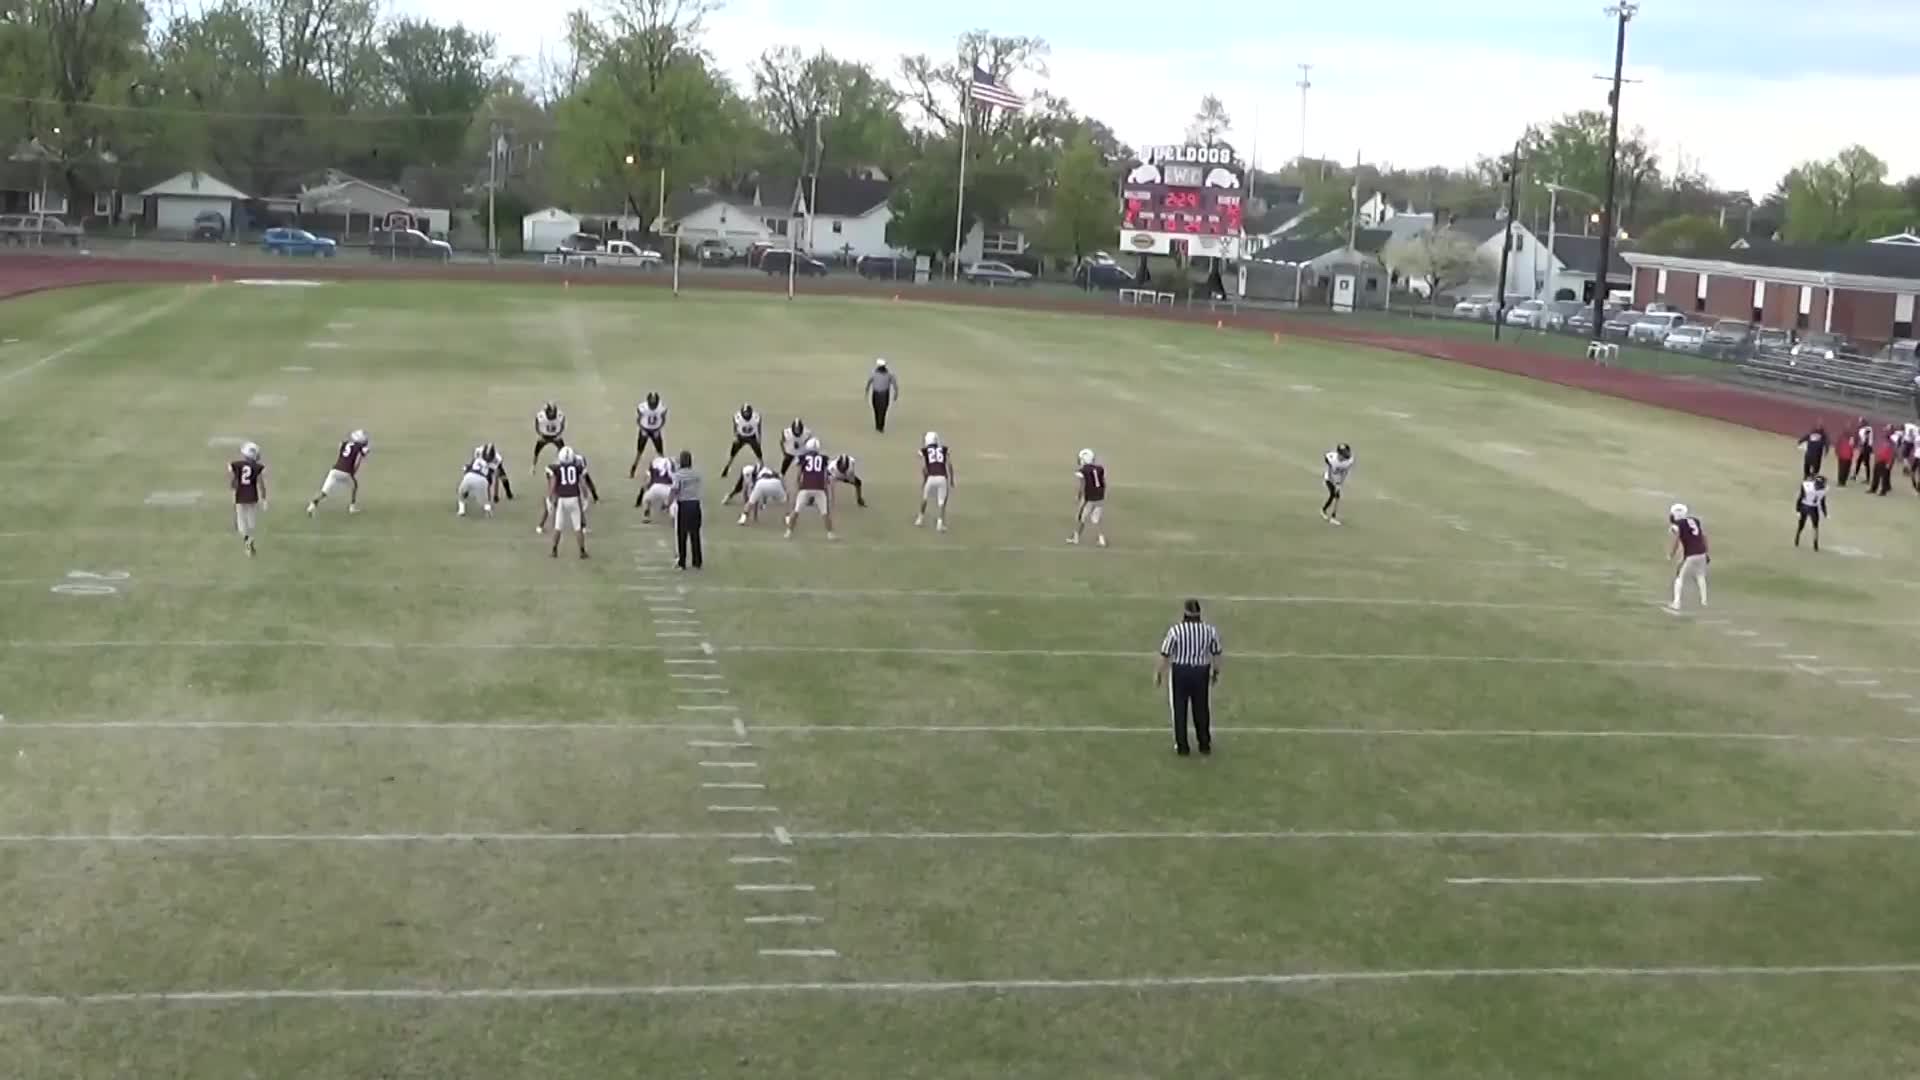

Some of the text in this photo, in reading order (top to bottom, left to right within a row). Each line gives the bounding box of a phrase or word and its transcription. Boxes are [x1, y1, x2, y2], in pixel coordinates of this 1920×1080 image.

[342, 441, 355, 457] 5
[927, 447, 944, 463] 26
[804, 455, 823, 472] 30
[241, 465, 251, 485] 2
[560, 466, 577, 485] 10
[1092, 468, 1101, 488] 1
[1687, 518, 1699, 536] 9
